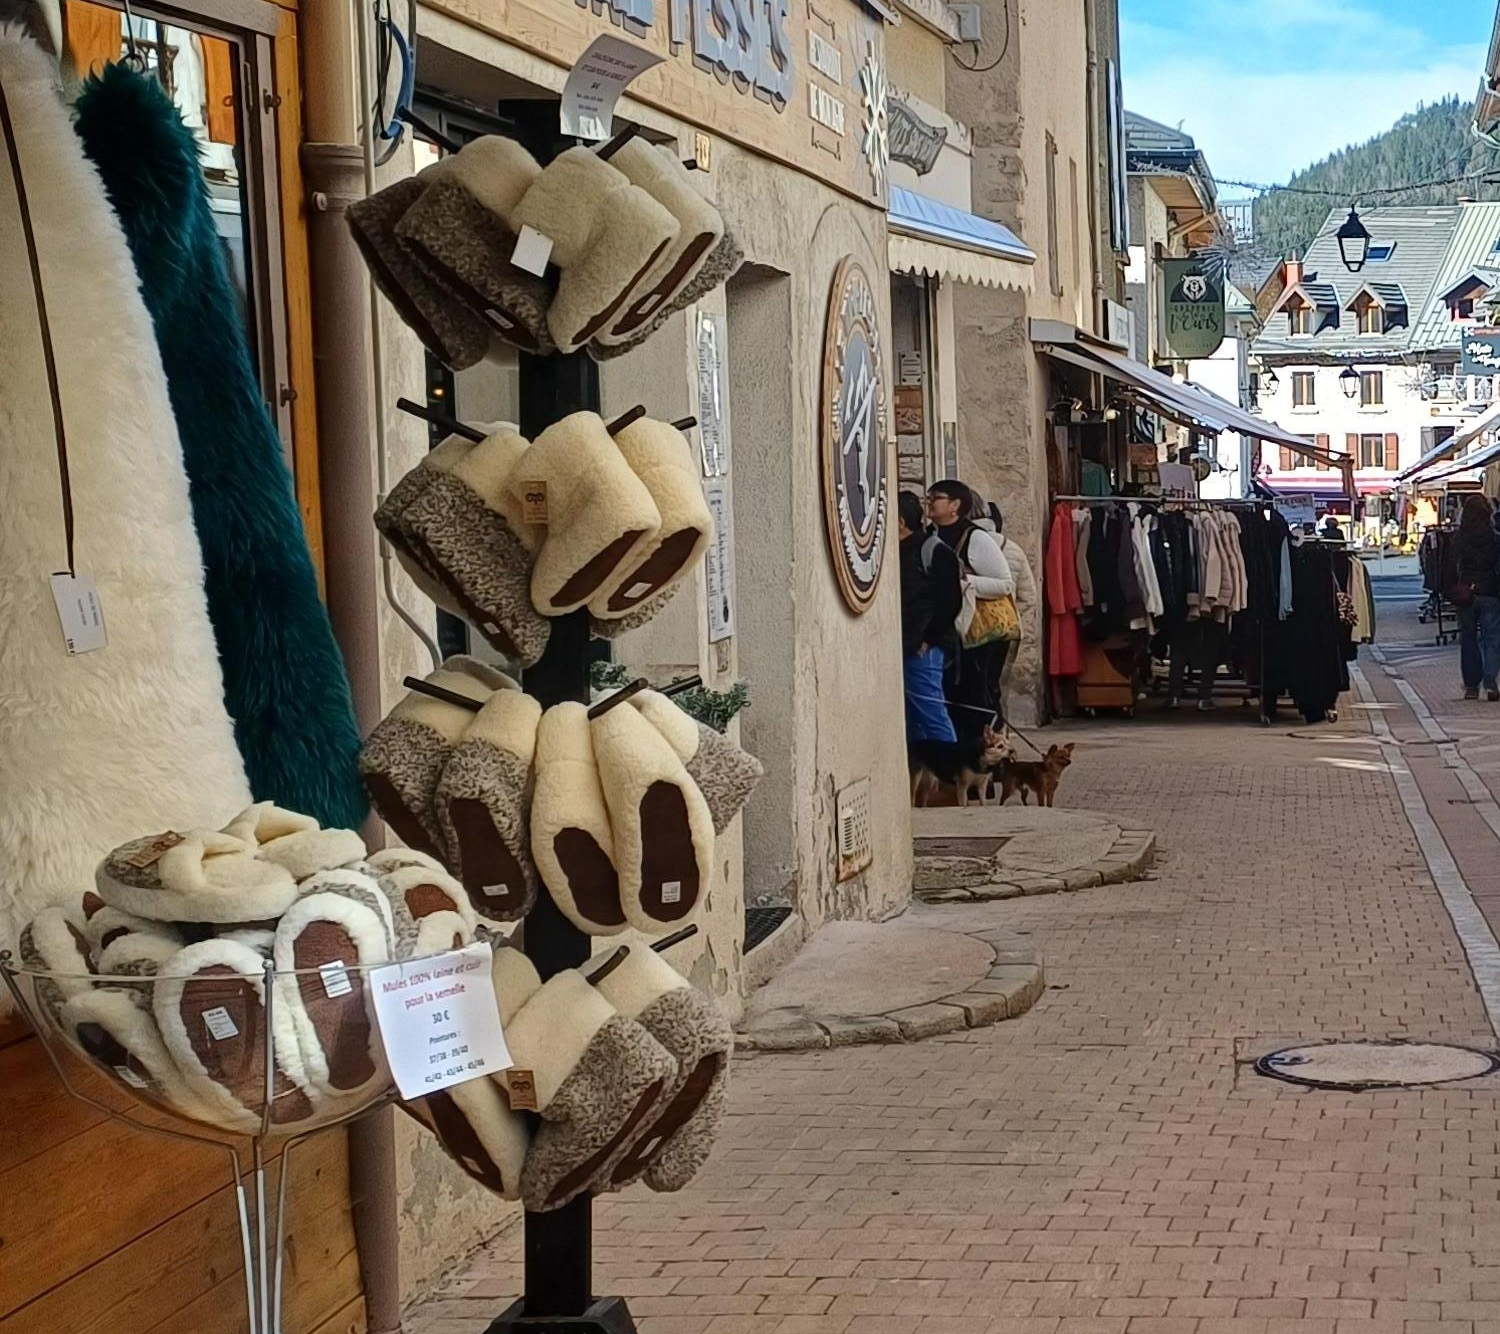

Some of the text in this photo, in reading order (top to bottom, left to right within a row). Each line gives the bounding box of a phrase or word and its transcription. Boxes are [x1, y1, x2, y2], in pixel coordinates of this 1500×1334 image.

[383, 960, 481, 993] Mules 100% laine et cuir
[405, 983, 465, 1010] pour la semelle
[432, 1010, 450, 1024] 30 €
